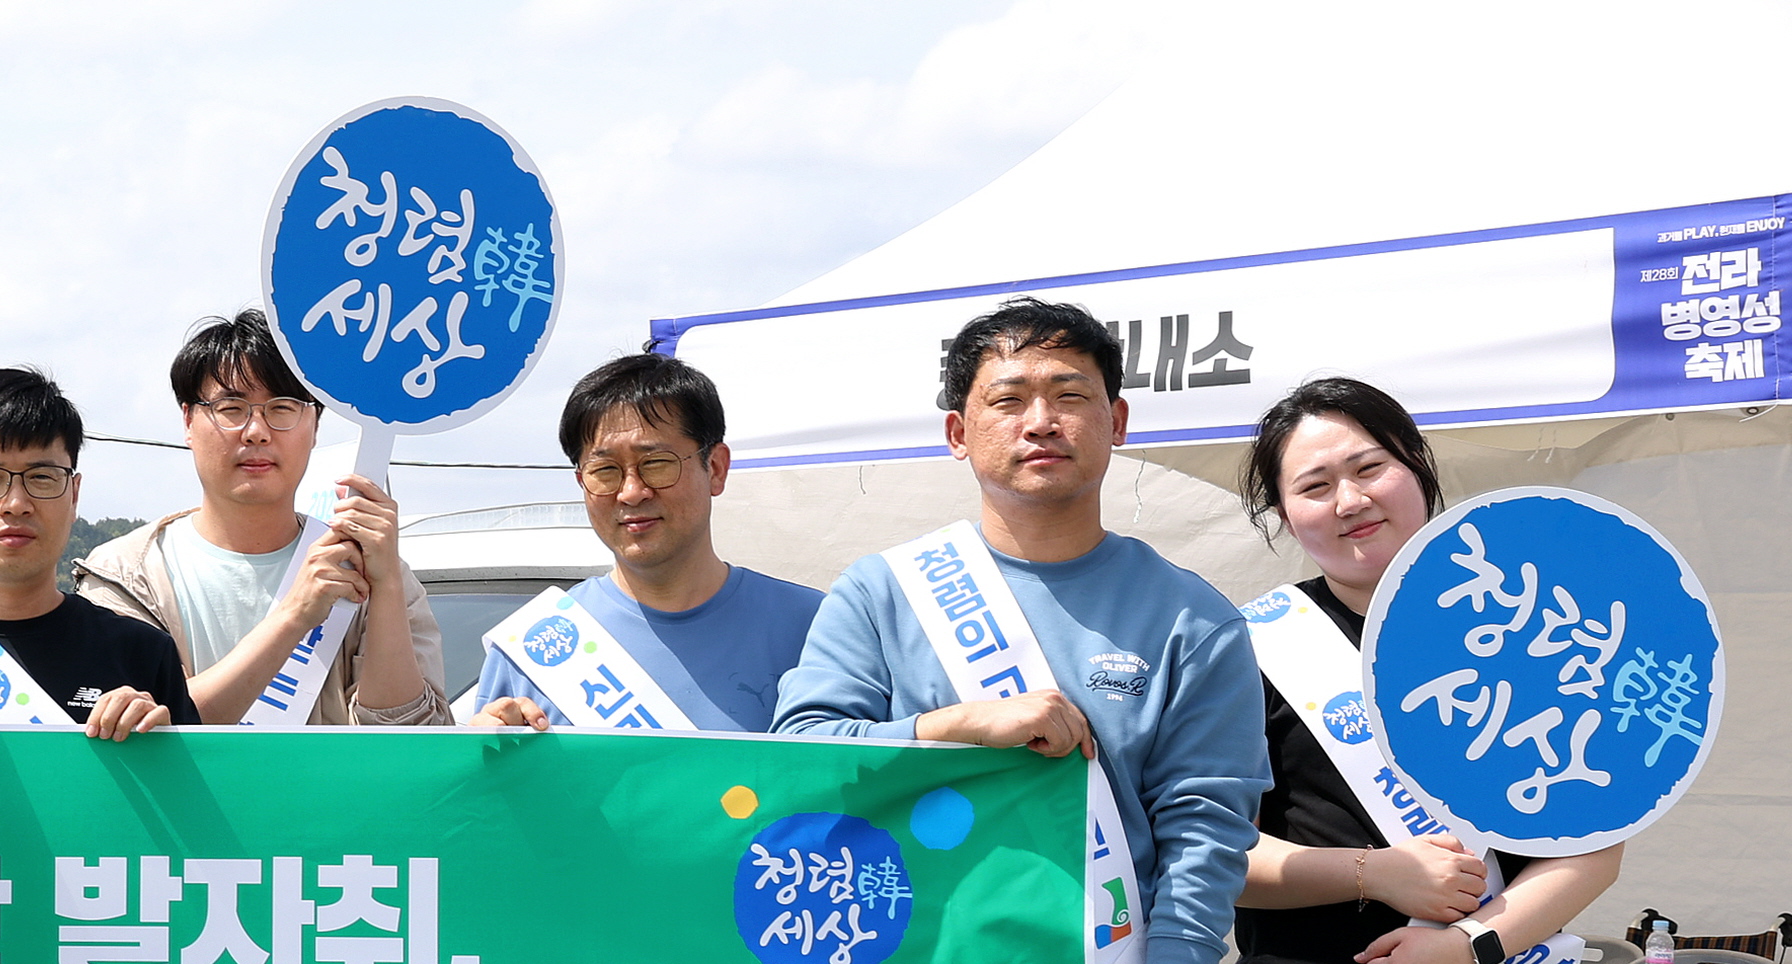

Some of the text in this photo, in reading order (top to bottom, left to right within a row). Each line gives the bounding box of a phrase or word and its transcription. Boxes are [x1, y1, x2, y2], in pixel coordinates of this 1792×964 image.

[315, 146, 476, 284] 청렴
[1683, 225, 1719, 240] PLAY.
[1746, 217, 1785, 233] ENJOY
[1640, 247, 1762, 295] 제28회 전라
[300, 278, 486, 399] 세상
[1660, 290, 1782, 341] 병영성
[1684, 339, 1765, 383] 축제
[914, 542, 1009, 664] 청렴의
[1436, 522, 1627, 700] 청렴
[1088, 653, 1151, 672] TRAVEL WITH
[1102, 661, 1138, 673] OLIVER
[1400, 668, 1612, 815] 세상
[750, 843, 854, 905] 청렴
